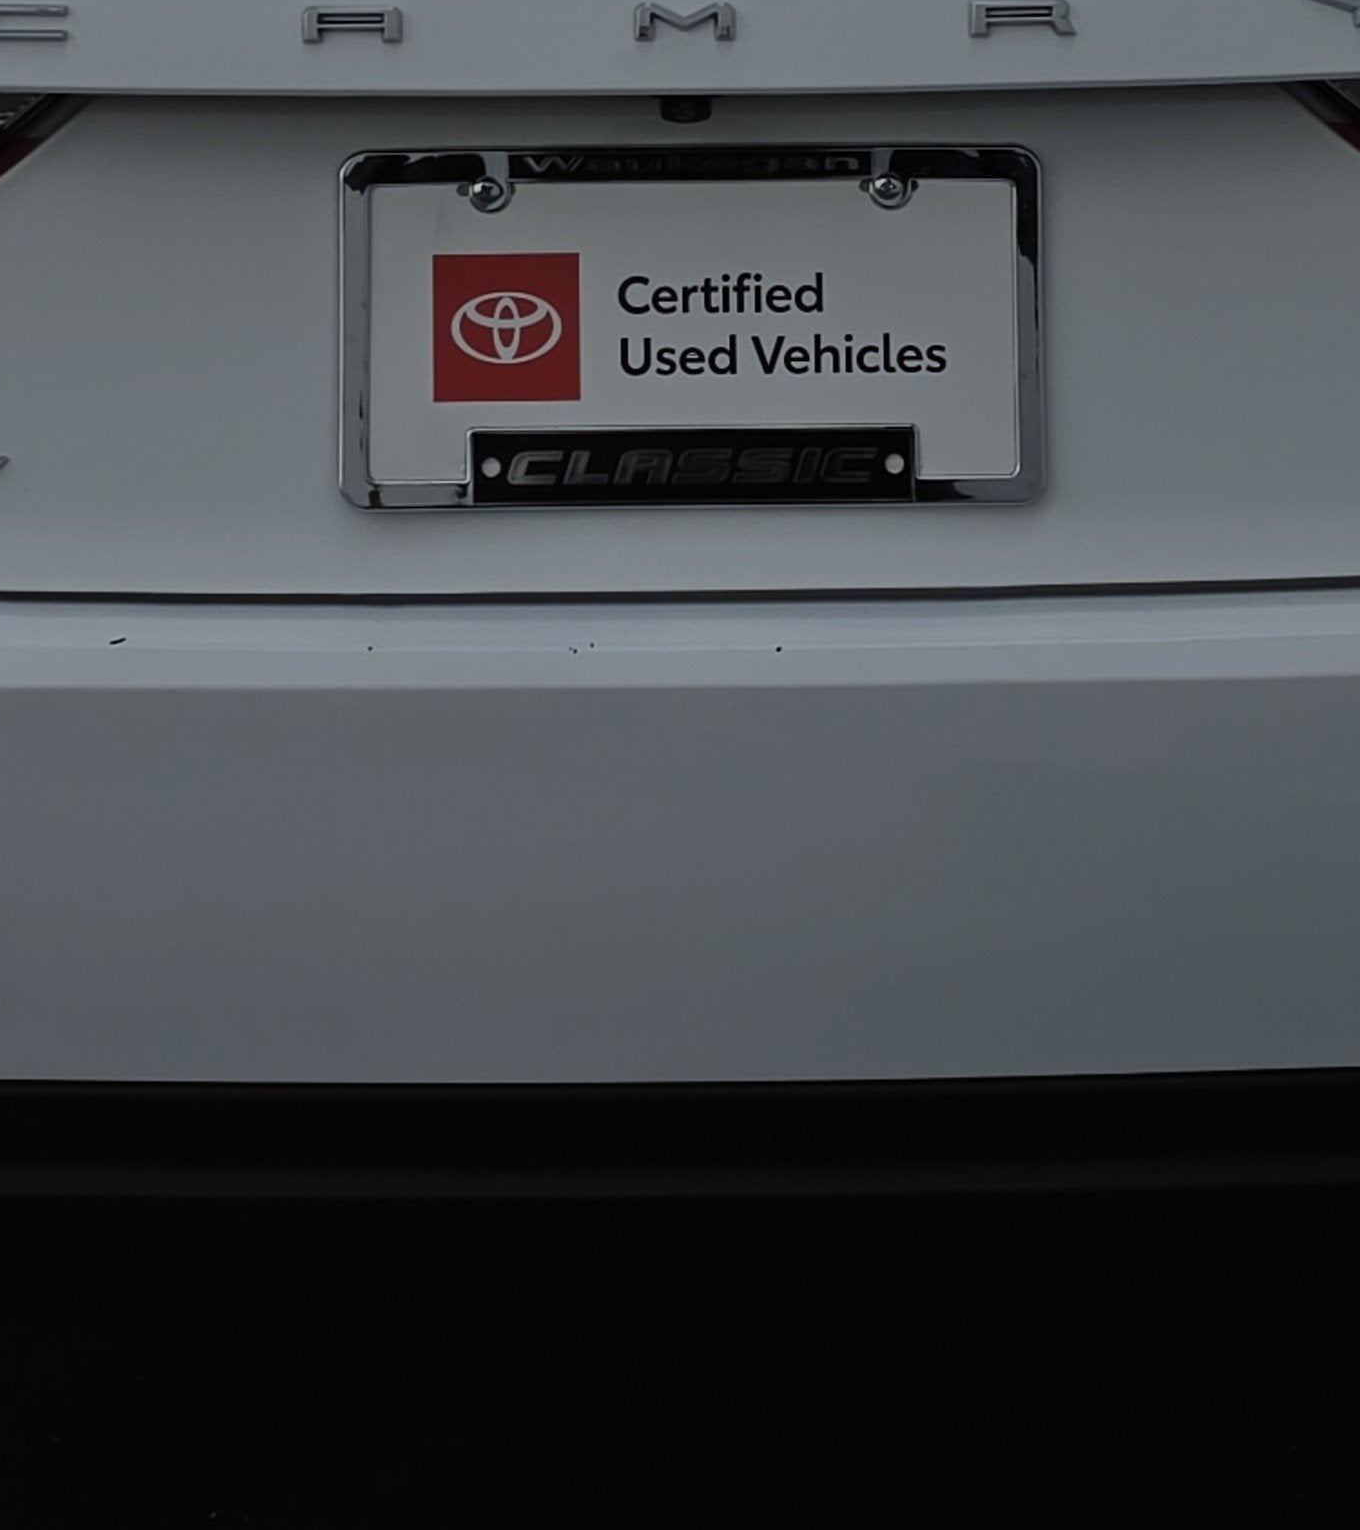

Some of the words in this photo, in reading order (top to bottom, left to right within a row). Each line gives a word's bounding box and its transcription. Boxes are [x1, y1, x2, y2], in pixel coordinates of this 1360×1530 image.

[617, 271, 825, 315] Certified
[619, 333, 738, 376] Used
[751, 332, 947, 375] Vehicles
[506, 446, 879, 487] CLASSIC
